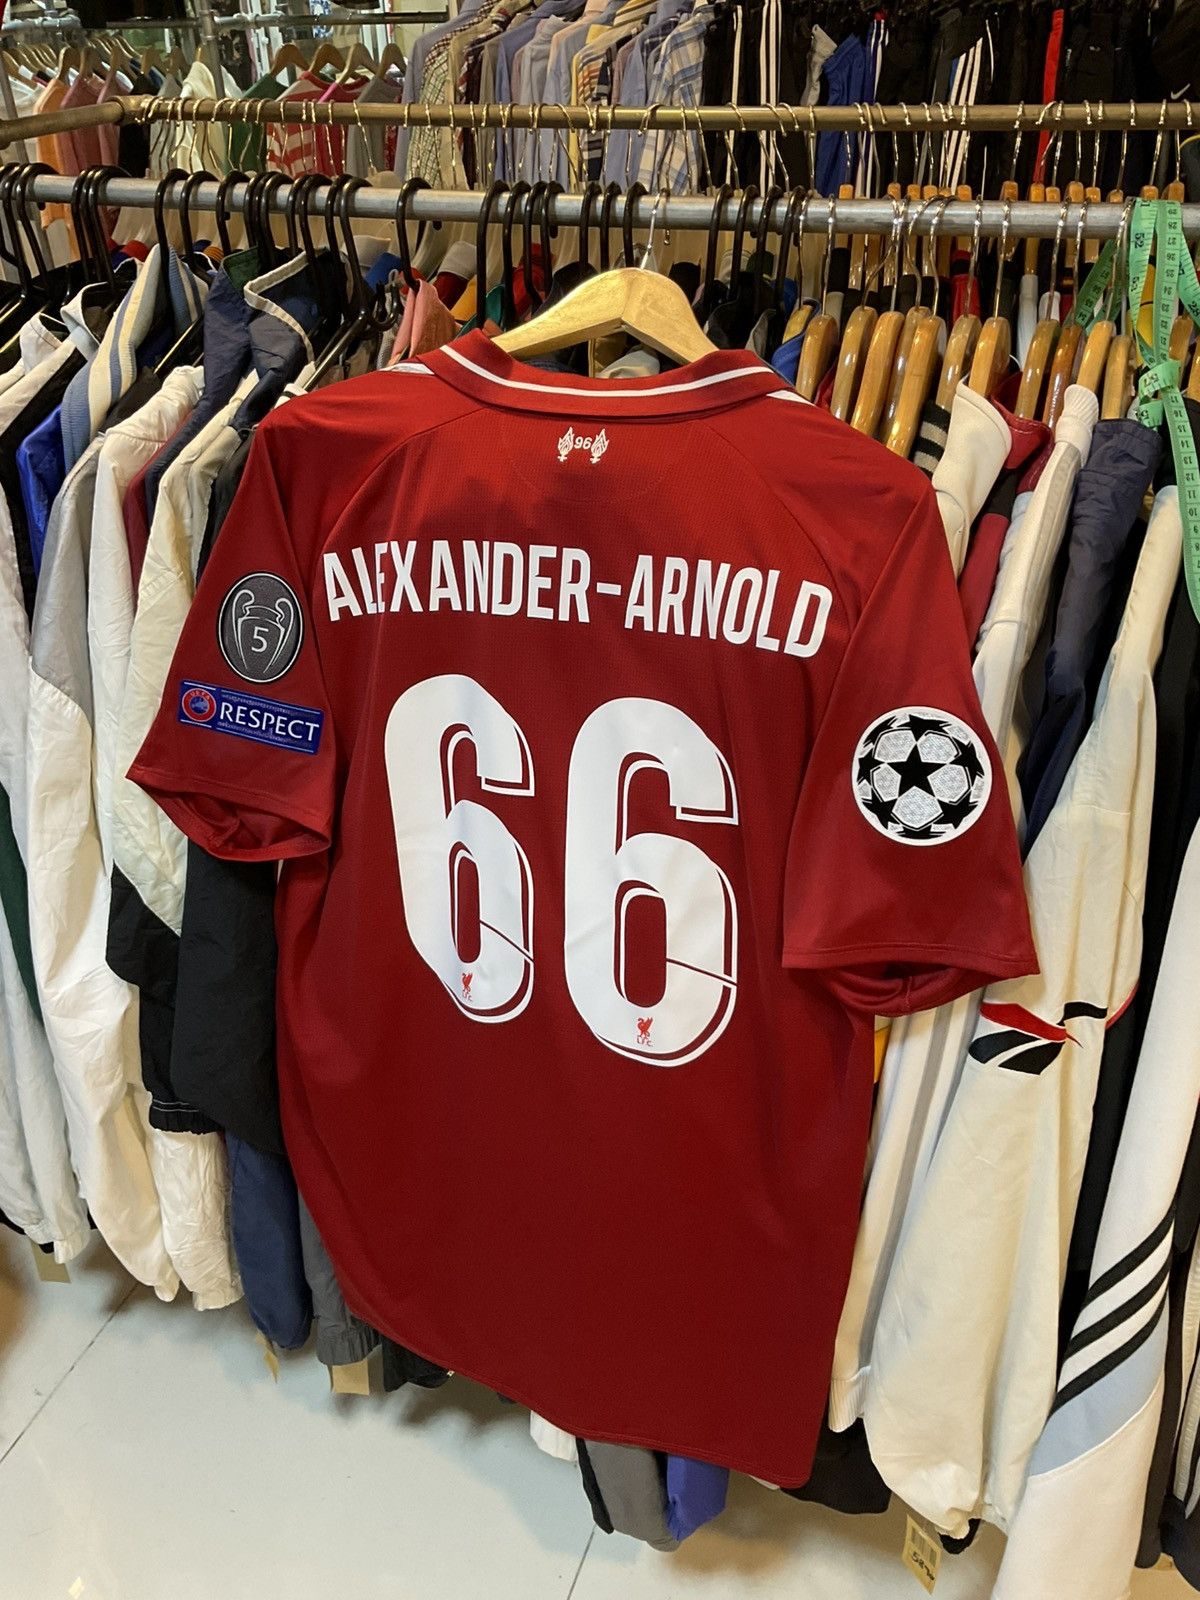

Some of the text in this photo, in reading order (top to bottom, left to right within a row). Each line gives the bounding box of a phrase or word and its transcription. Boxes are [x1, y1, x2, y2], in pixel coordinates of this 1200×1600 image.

[1167, 221, 1178, 230] 28
[1134, 232, 1145, 249] 52
[1167, 236, 1177, 246] 27
[1166, 252, 1176, 261] 26
[574, 436, 592, 450] 96
[1185, 472, 1196, 482] 12
[1187, 489, 1197, 500] 11
[1188, 507, 1198, 517] 10
[1193, 525, 1199, 534] 9
[322, 539, 833, 659] ALEXANDER-ARNOLD
[251, 625, 270, 653] 5
[220, 701, 320, 742] RESPECT
[384, 673, 739, 1068] 66
